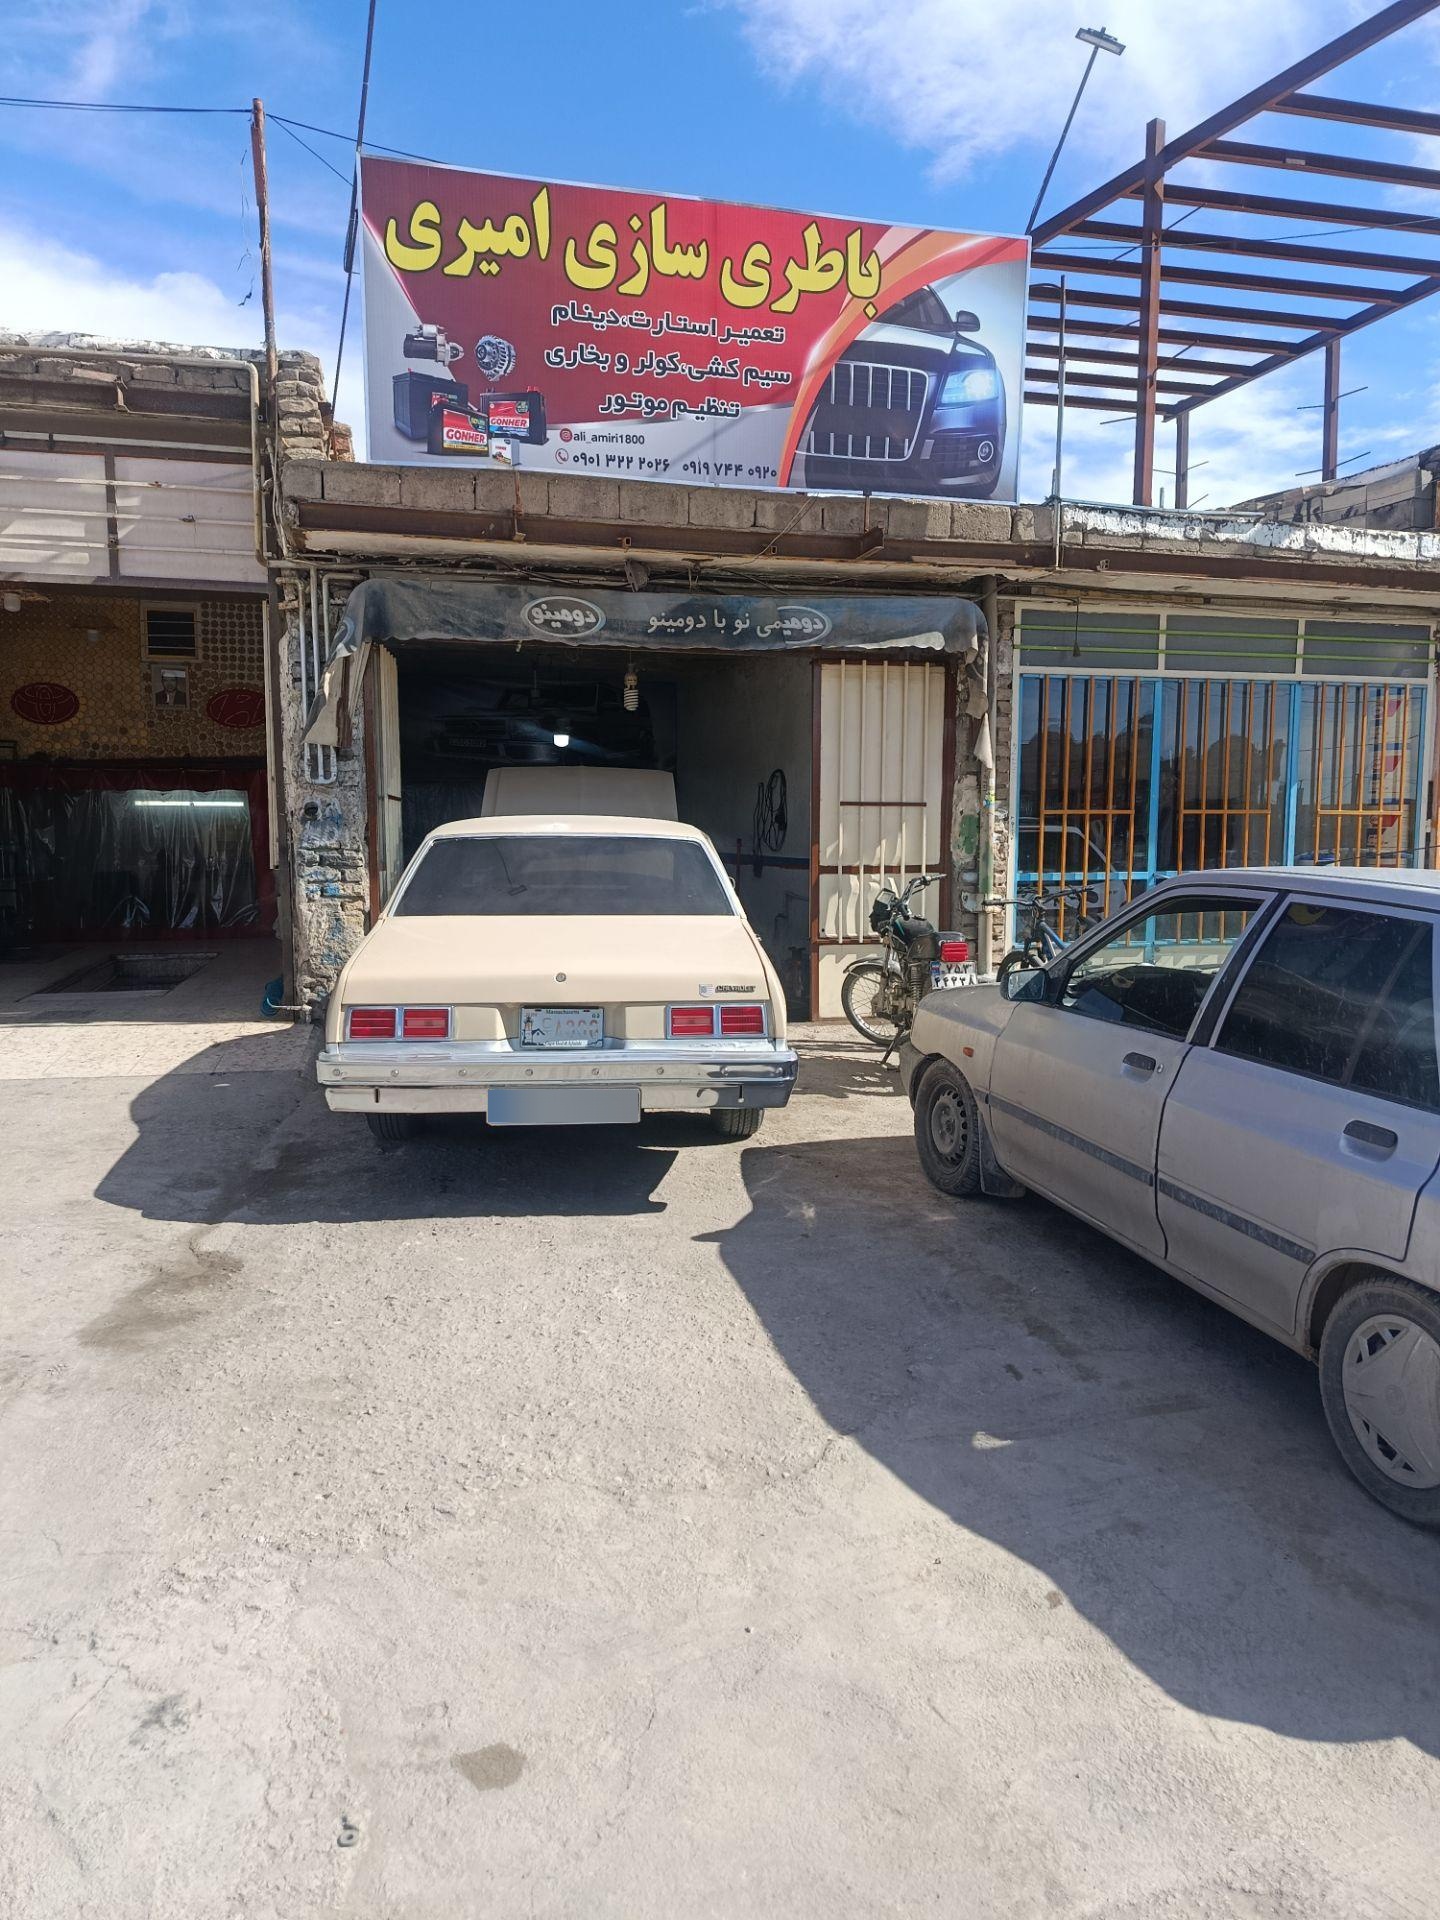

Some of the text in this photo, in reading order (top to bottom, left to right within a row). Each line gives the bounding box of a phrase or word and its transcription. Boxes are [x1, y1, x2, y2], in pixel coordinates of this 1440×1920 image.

[384, 184, 882, 320] باطری سازی امیری
[718, 325, 786, 347] تعمیر
[544, 343, 611, 372] بخاری
[615, 352, 629, 374] و
[742, 366, 792, 388] سیم
[599, 393, 742, 421] تنظیم موتور
[489, 418, 528, 428] GONHER
[445, 428, 487, 444] GONHER
[573, 432, 645, 445] ali_amiri1800
[572, 452, 600, 467] ۰۹۰۱
[714, 462, 744, 478] ۷۴۴
[747, 466, 778, 480] ۰۹۲۰
[647, 611, 706, 634] دومینو
[713, 609, 726, 634] با
[733, 611, 751, 635] نو
